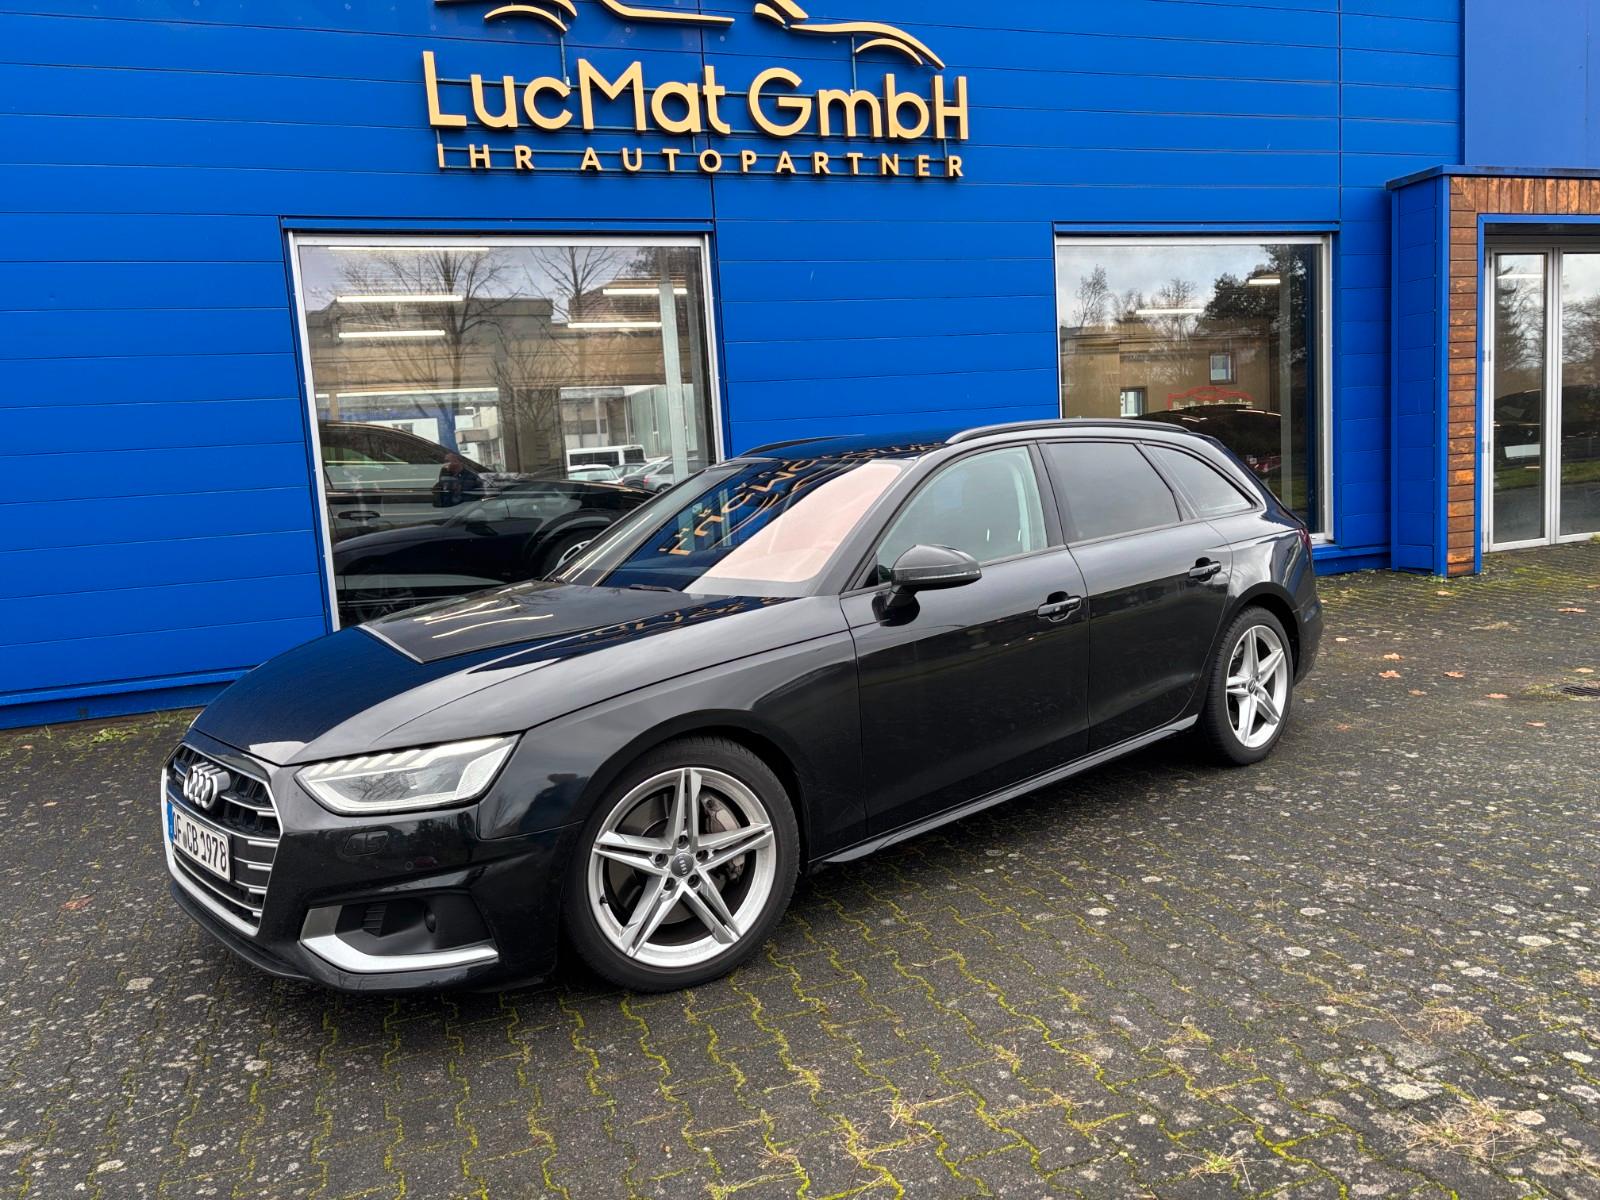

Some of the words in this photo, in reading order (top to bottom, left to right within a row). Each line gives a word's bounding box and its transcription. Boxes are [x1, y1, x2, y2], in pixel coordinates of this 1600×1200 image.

[422, 50, 731, 136] LucMat
[748, 67, 970, 140] GmbH
[437, 143, 535, 170] IHR
[579, 147, 964, 177] AUTOPARTNER
[200, 830, 227, 873] 1978
